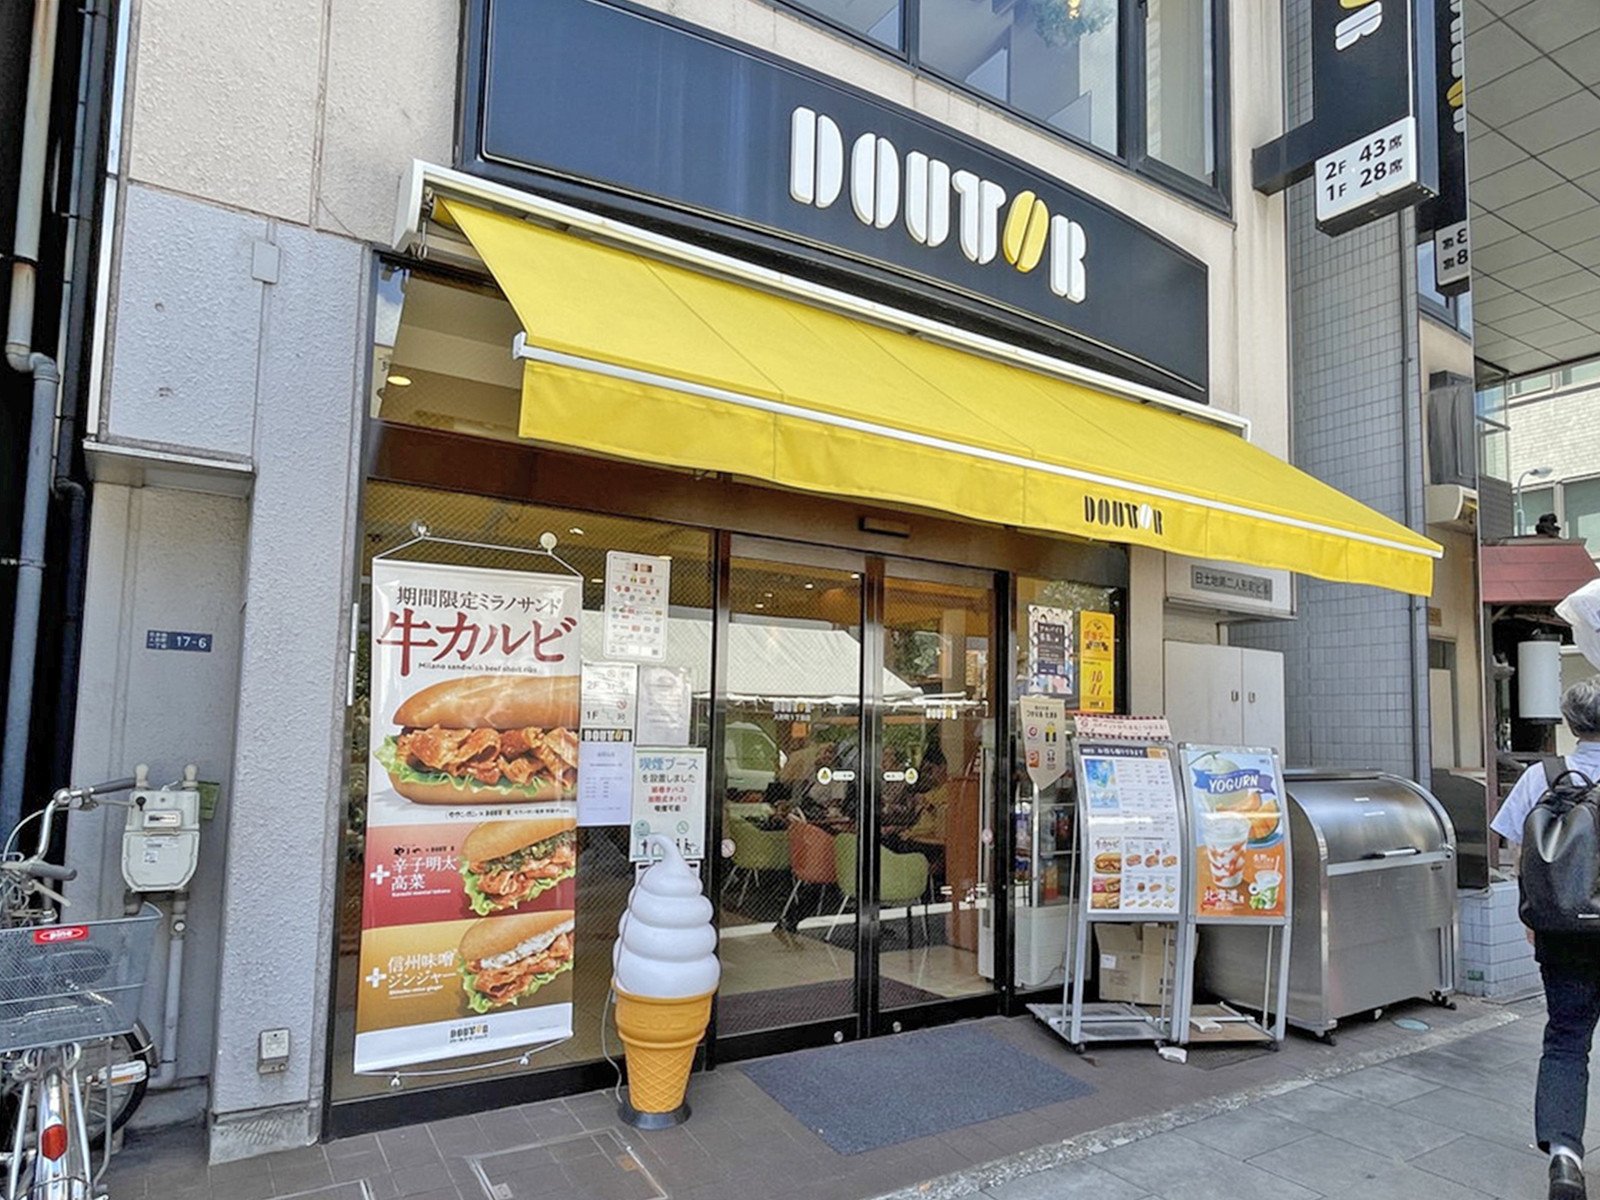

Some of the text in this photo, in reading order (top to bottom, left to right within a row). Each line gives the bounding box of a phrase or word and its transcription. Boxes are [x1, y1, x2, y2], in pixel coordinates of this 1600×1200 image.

[1325, 134, 1403, 180] 2F 43席
[1326, 158, 1403, 201] 1F 28席
[790, 106, 1087, 304] DOUTOR
[1084, 495, 1163, 536] DOUTOR
[397, 586, 560, 615] 期間限定ミラノサンド
[176, 635, 208, 649] 17-6
[376, 608, 578, 677] 牛カルビ
[639, 757, 699, 771] 喫煙ブース
[1209, 774, 1259, 793] YOGURN
[389, 970, 457, 988] ジンジャー
